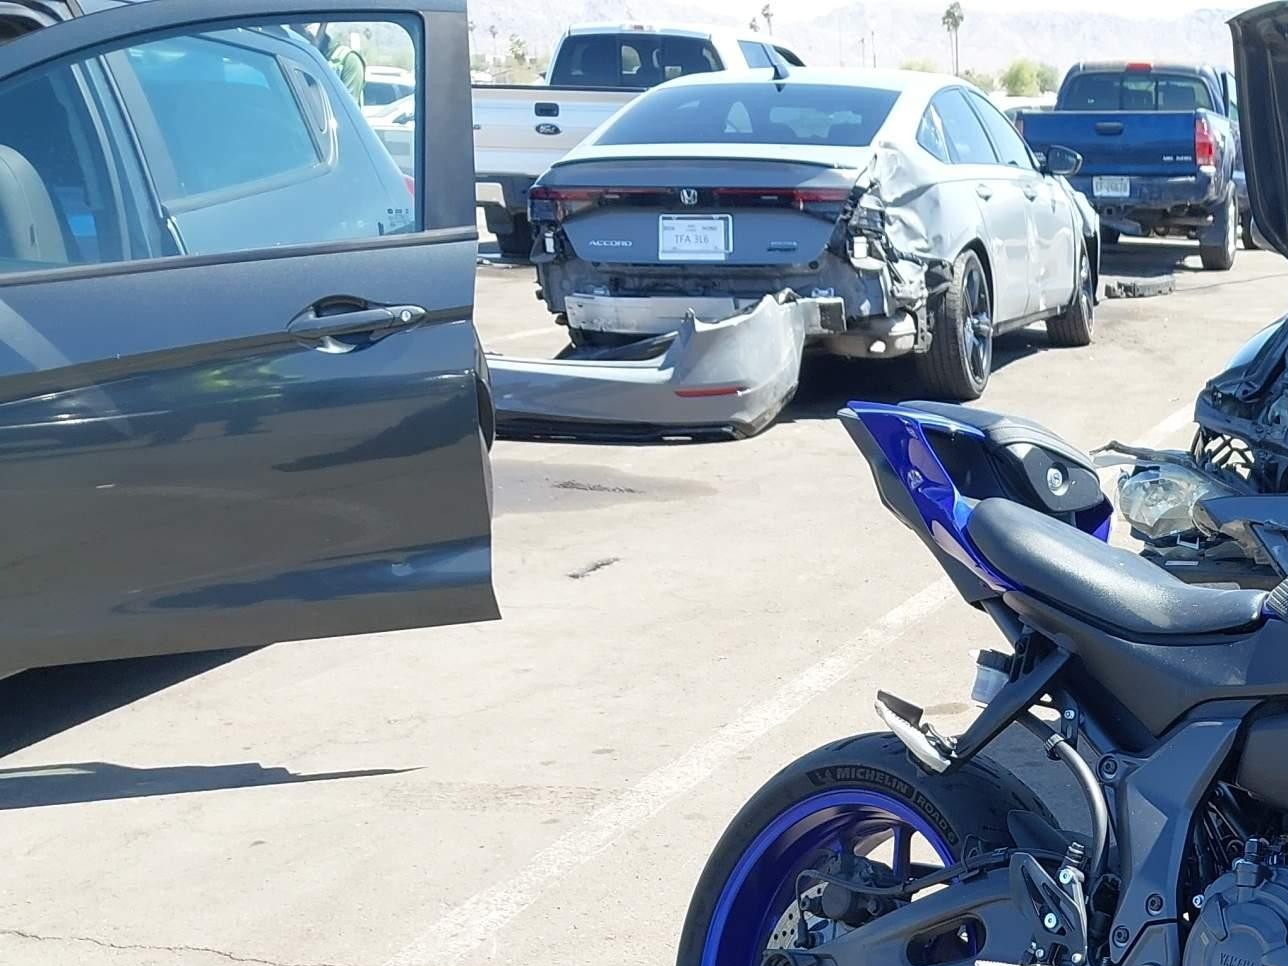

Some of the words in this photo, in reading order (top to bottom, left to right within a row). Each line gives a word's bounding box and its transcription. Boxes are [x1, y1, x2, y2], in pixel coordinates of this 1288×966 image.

[588, 239, 633, 247] ACCORD
[836, 766, 909, 794] MICHELIN
[916, 794, 949, 830] ROAD
